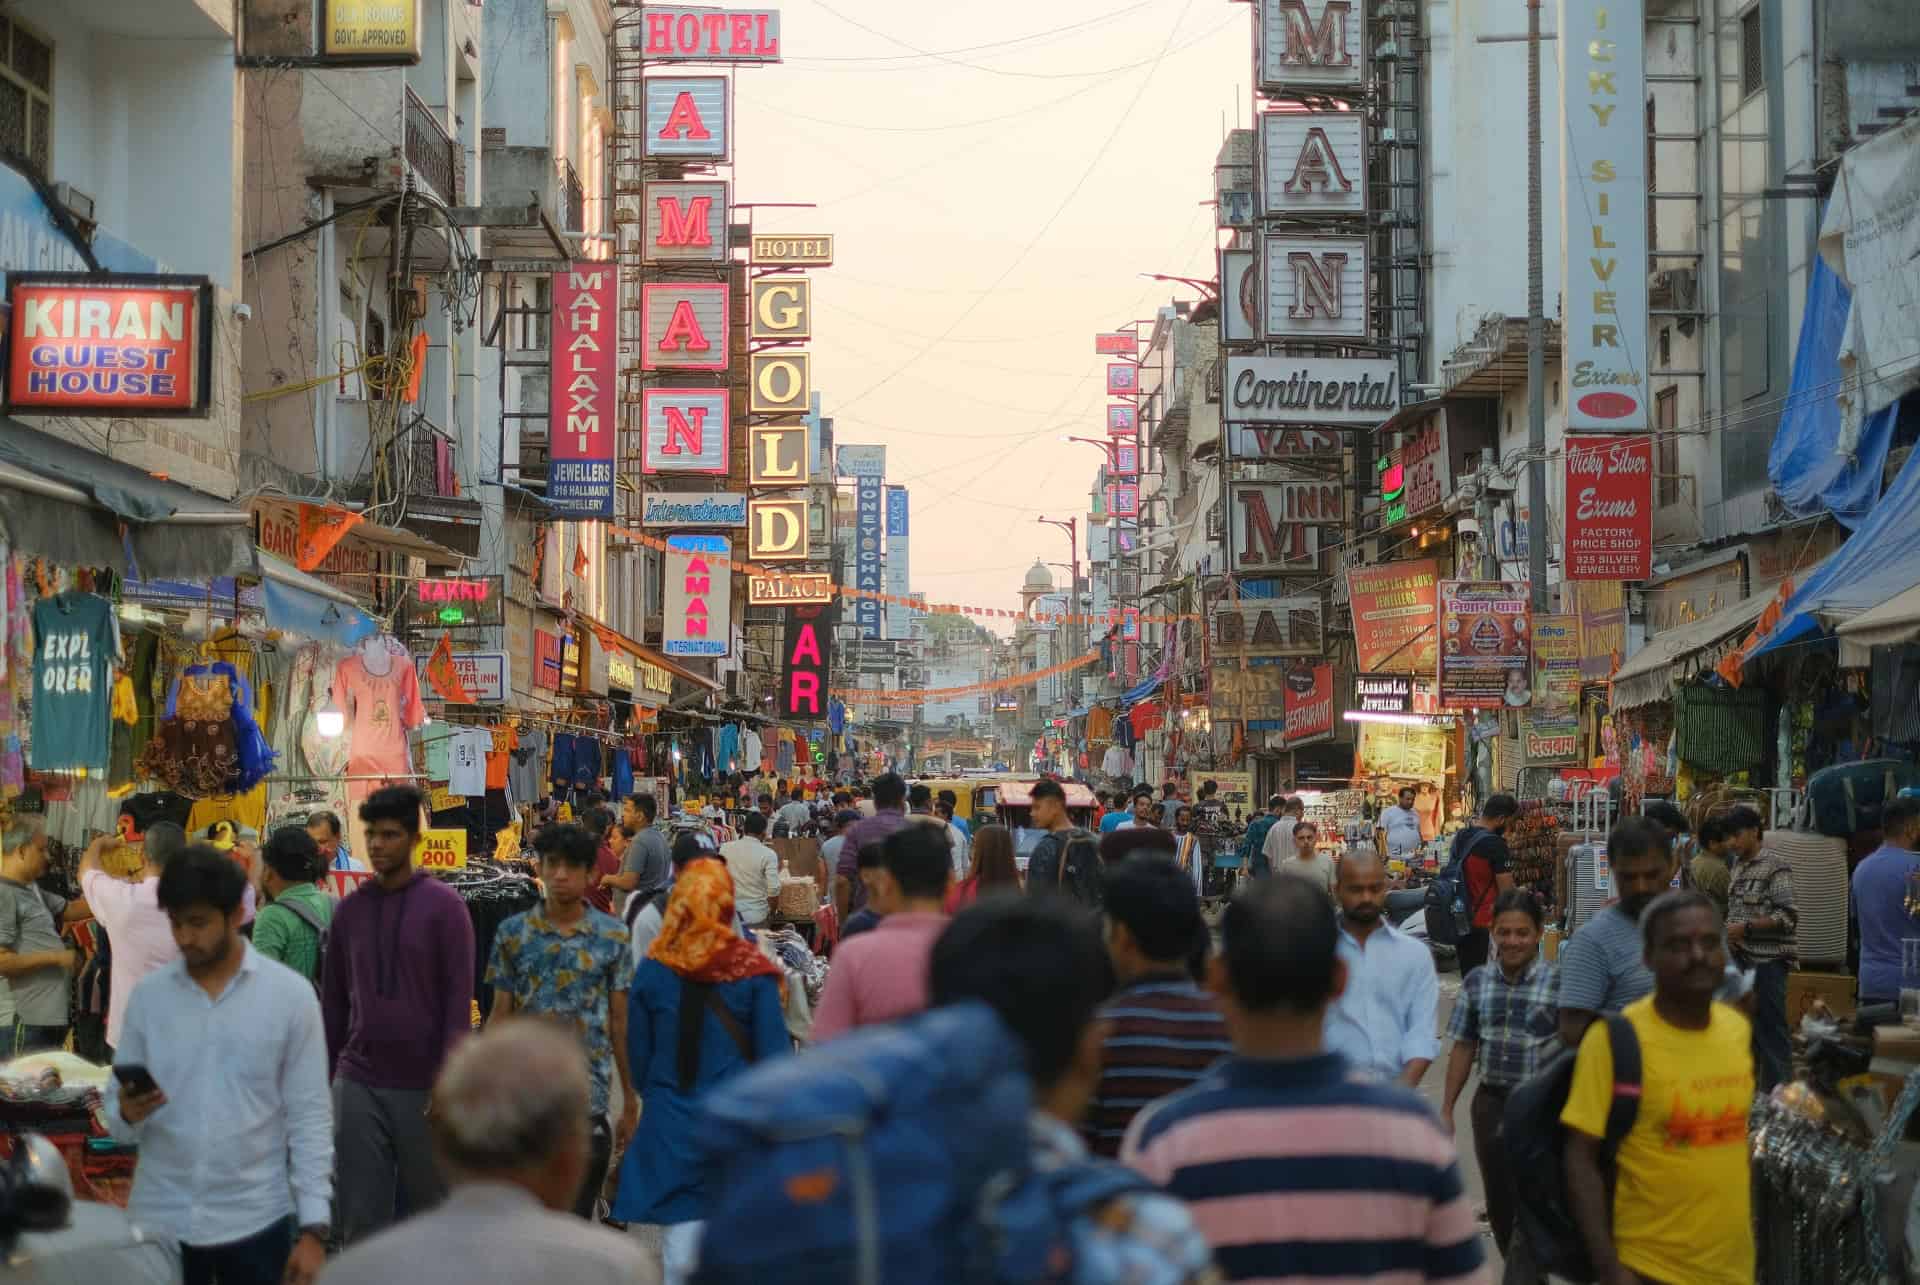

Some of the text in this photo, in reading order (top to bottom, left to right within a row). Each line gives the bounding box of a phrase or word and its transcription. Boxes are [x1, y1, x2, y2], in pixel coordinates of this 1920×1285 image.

[336, 29, 406, 46] GOVT. APPROVED
[646, 13, 777, 55] HOTEL
[758, 242, 827, 259] HOTEL
[1590, 160, 1616, 347] SILVER
[656, 91, 712, 456] AMAN
[24, 298, 184, 341] KIRAN
[32, 346, 176, 370] GUEST
[567, 272, 603, 453] MAHALAXMI
[29, 372, 176, 397] HOUSE
[1233, 369, 1396, 411] Continental
[757, 286, 803, 552] GOLD
[554, 464, 610, 482] JEWELLERS
[1567, 444, 1648, 480] Vicky Silver
[554, 485, 610, 497] 916 HALLMARK
[1286, 486, 1342, 520] INN
[643, 498, 746, 522] International
[861, 478, 878, 536] MONEY
[1573, 538, 1641, 549] PRICE SHOP
[1581, 528, 1634, 538] FACTORY
[1574, 565, 1641, 575] JEWELLERY
[1577, 554, 1639, 565] 925 SILVER
[686, 556, 711, 637] AMAN
[755, 579, 826, 598] PALACE
[480, 673, 498, 684] INN
[1285, 699, 1331, 732] RESTAURANT
[1362, 696, 1402, 711] JEWELLERS
[427, 839, 451, 850] SALE
[423, 851, 456, 866] 200
